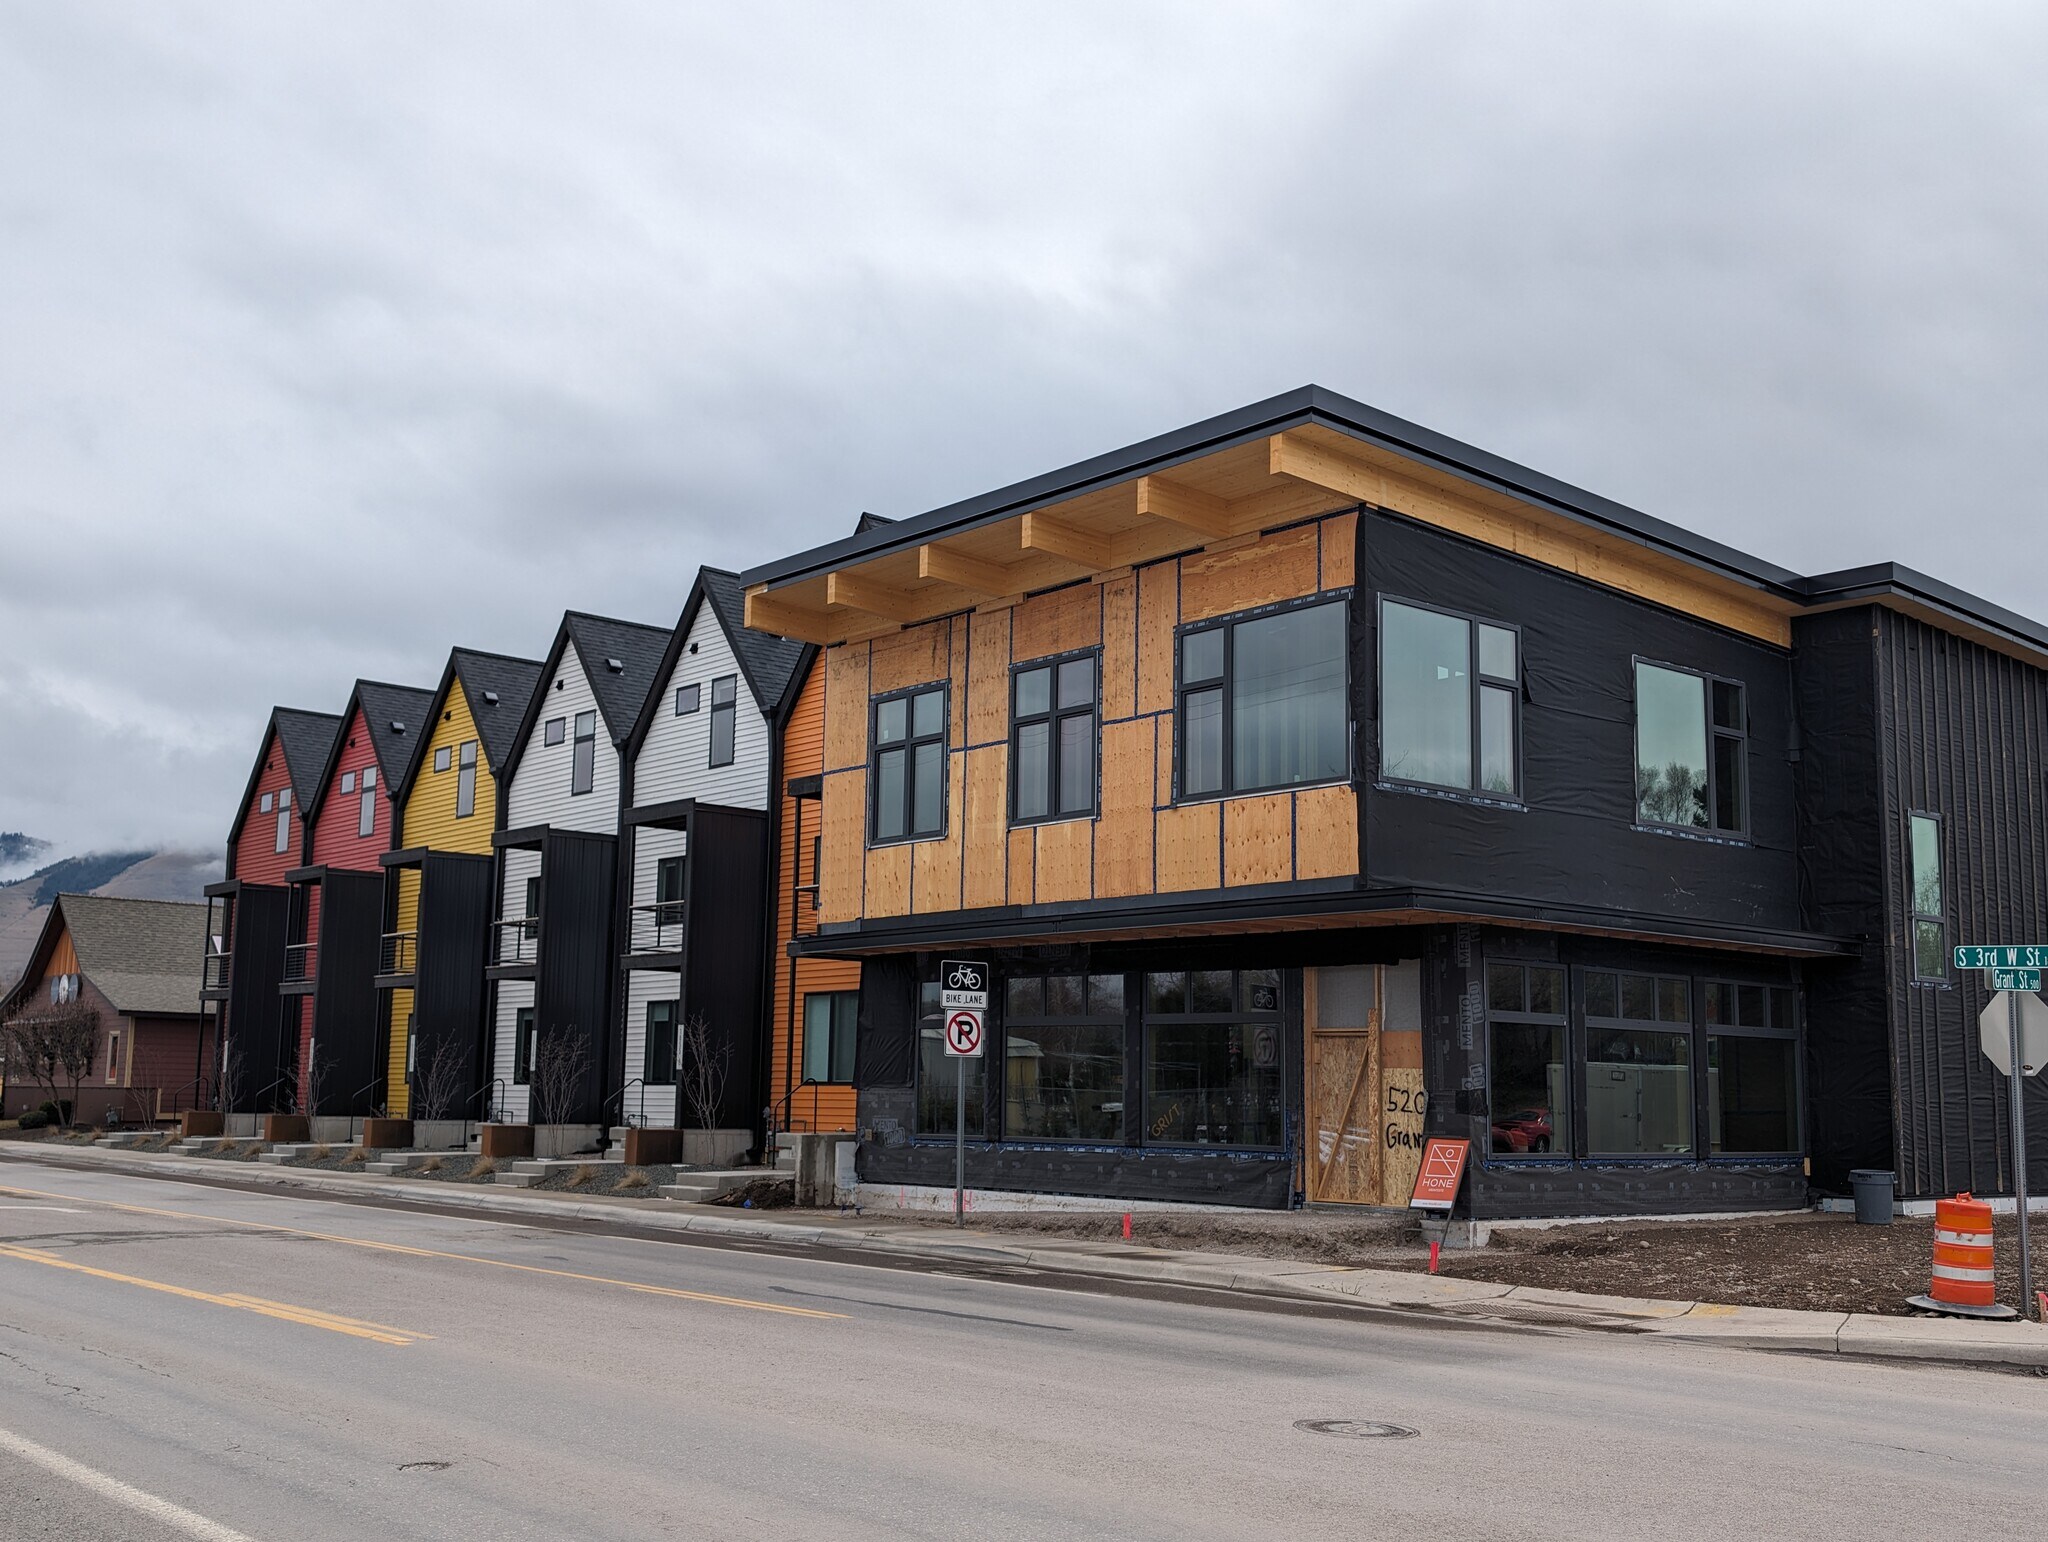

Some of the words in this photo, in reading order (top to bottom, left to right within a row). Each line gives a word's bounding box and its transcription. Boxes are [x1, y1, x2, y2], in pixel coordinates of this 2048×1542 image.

[1959, 948, 1966, 966] S
[1976, 948, 1997, 966] 3rd
[2006, 948, 2017, 966] W
[2026, 947, 2040, 966] St
[1994, 970, 2014, 989] Grant
[2019, 971, 2028, 989] St
[946, 993, 961, 1003] BIKE
[965, 994, 983, 1004] LANE
[1461, 997, 1472, 1046] MENTO
[1422, 1178, 1454, 1188] HONE
